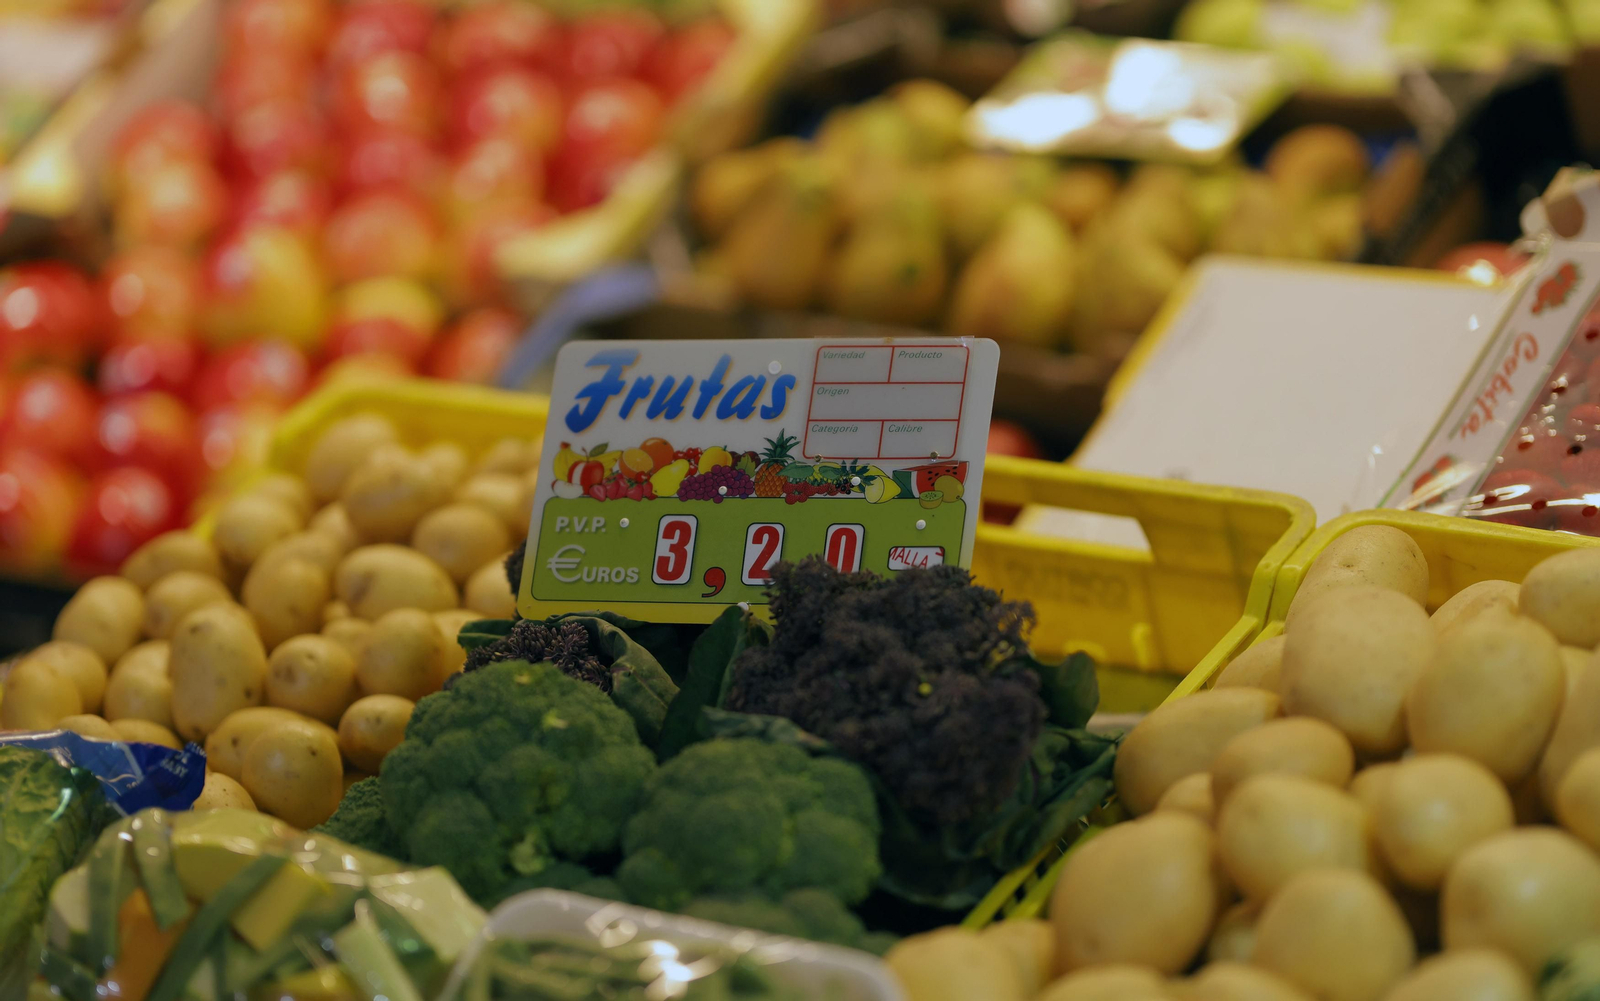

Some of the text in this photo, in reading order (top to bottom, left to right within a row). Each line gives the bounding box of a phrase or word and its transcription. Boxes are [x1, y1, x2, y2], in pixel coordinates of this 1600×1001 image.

[823, 350, 866, 360] Variedad
[898, 350, 944, 360] Producto
[565, 349, 796, 433] Frutas
[817, 386, 850, 398] Origen
[888, 423, 923, 433] Calibre
[555, 516, 606, 533] P.V.P.
